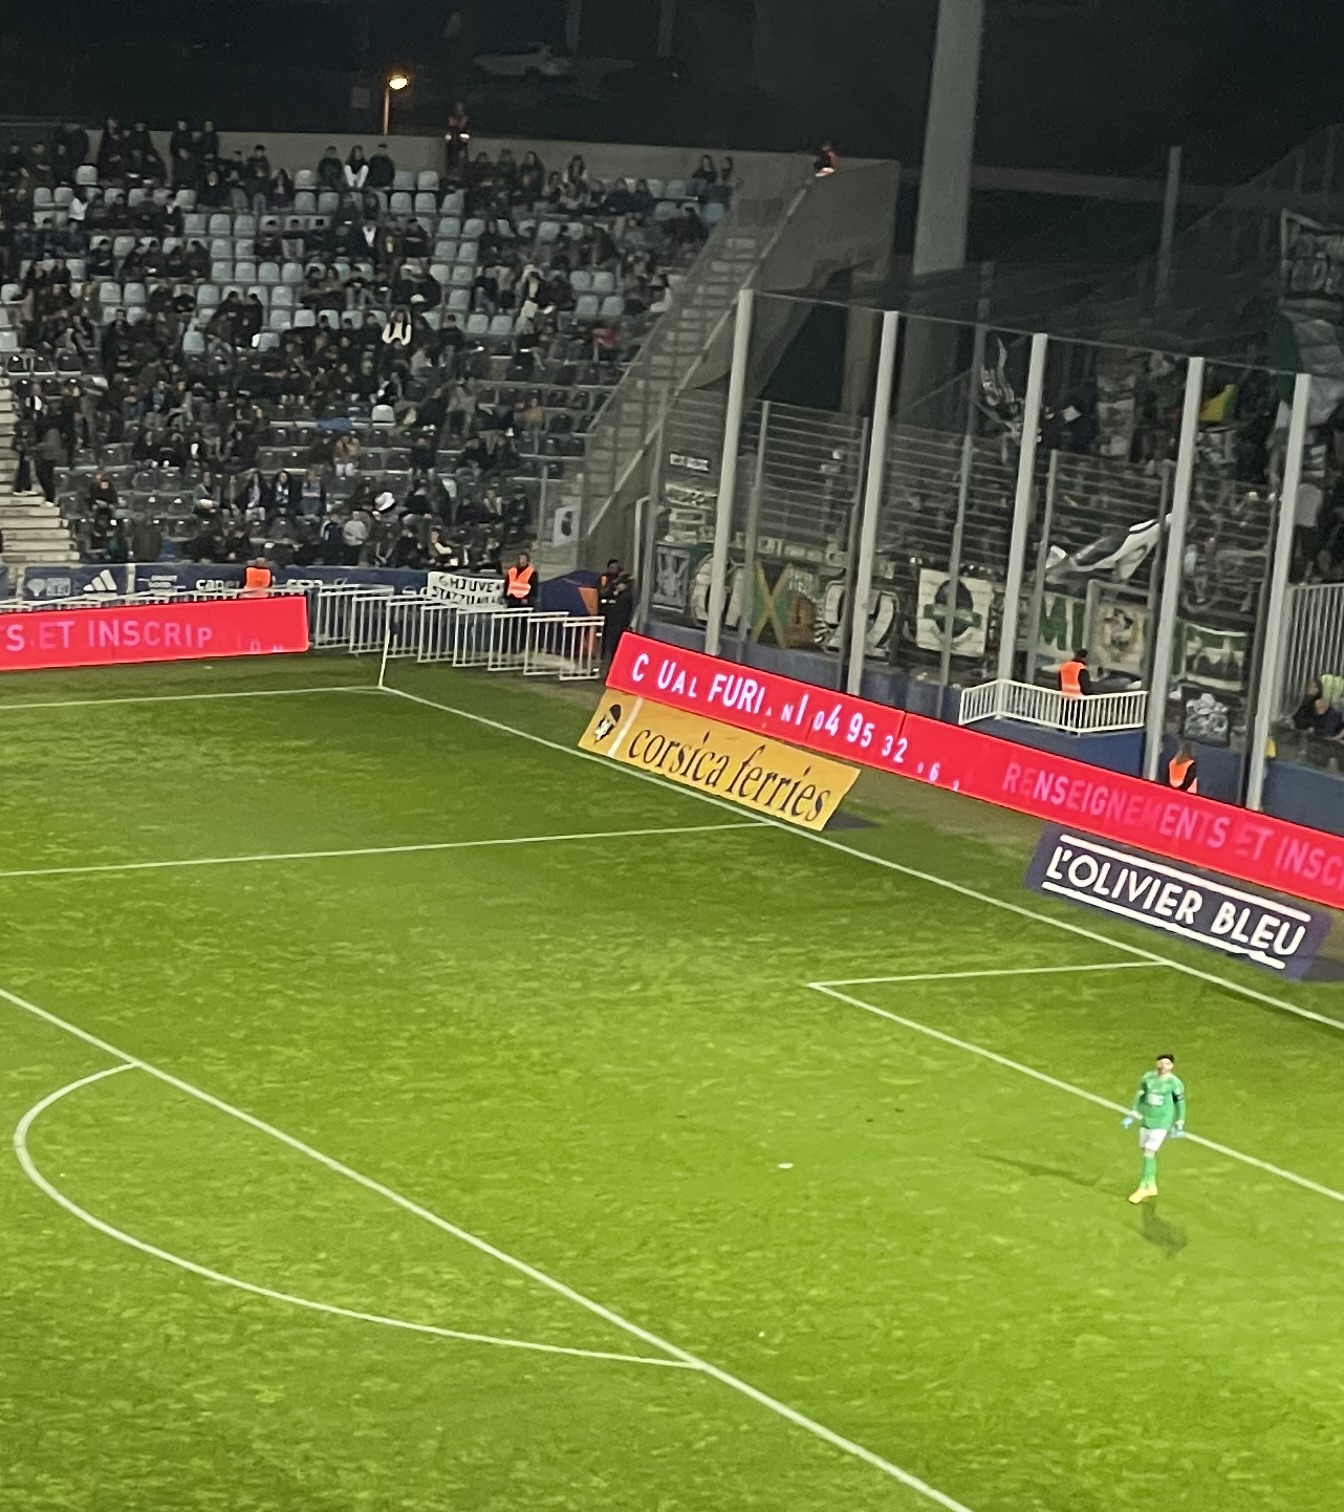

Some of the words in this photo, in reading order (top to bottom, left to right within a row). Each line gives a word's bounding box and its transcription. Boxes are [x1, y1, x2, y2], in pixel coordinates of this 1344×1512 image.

[39, 620, 75, 649] ET
[813, 703, 840, 736] 04
[850, 711, 876, 748] 95
[882, 734, 909, 764] 32
[630, 729, 730, 790] corsica
[729, 743, 831, 823] ferries
[1236, 823, 1275, 861] ET
[1045, 846, 1204, 925] L'OLIVIER
[1211, 889, 1306, 957] BLEU
